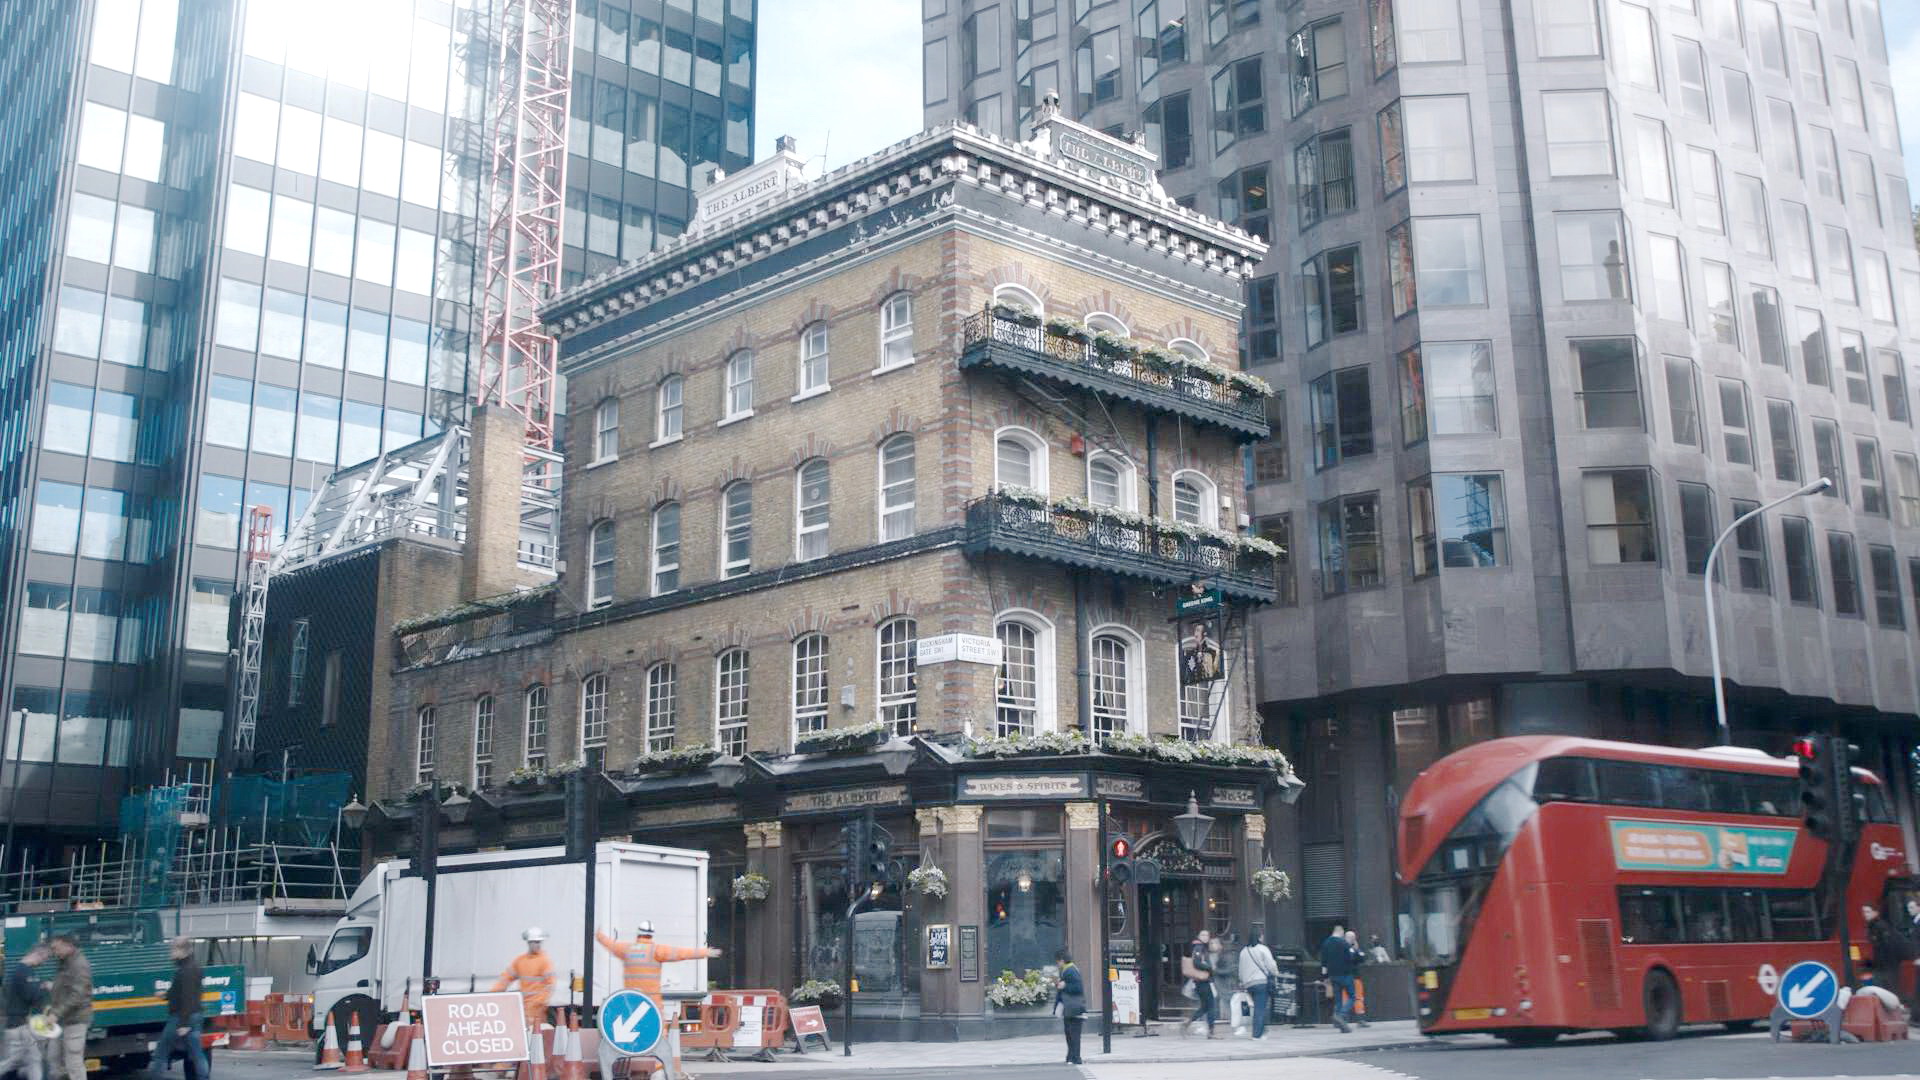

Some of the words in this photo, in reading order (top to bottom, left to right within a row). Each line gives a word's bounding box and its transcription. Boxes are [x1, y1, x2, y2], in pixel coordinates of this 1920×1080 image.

[706, 198, 728, 215] THE
[732, 175, 778, 205] ALBERT
[919, 637, 953, 649] BUCKINGHAM
[961, 637, 991, 647] VICTORIA
[961, 645, 985, 654] STREET
[979, 783, 1013, 791] WINES
[1027, 782, 1068, 790] SPIRITS
[810, 794, 832, 807] THE
[931, 931, 947, 939] LIVE
[932, 950, 945, 960] sky
[448, 1003, 500, 1018] ROAD
[446, 1020, 507, 1037] AHEAD
[441, 1037, 514, 1055] CLOSED
